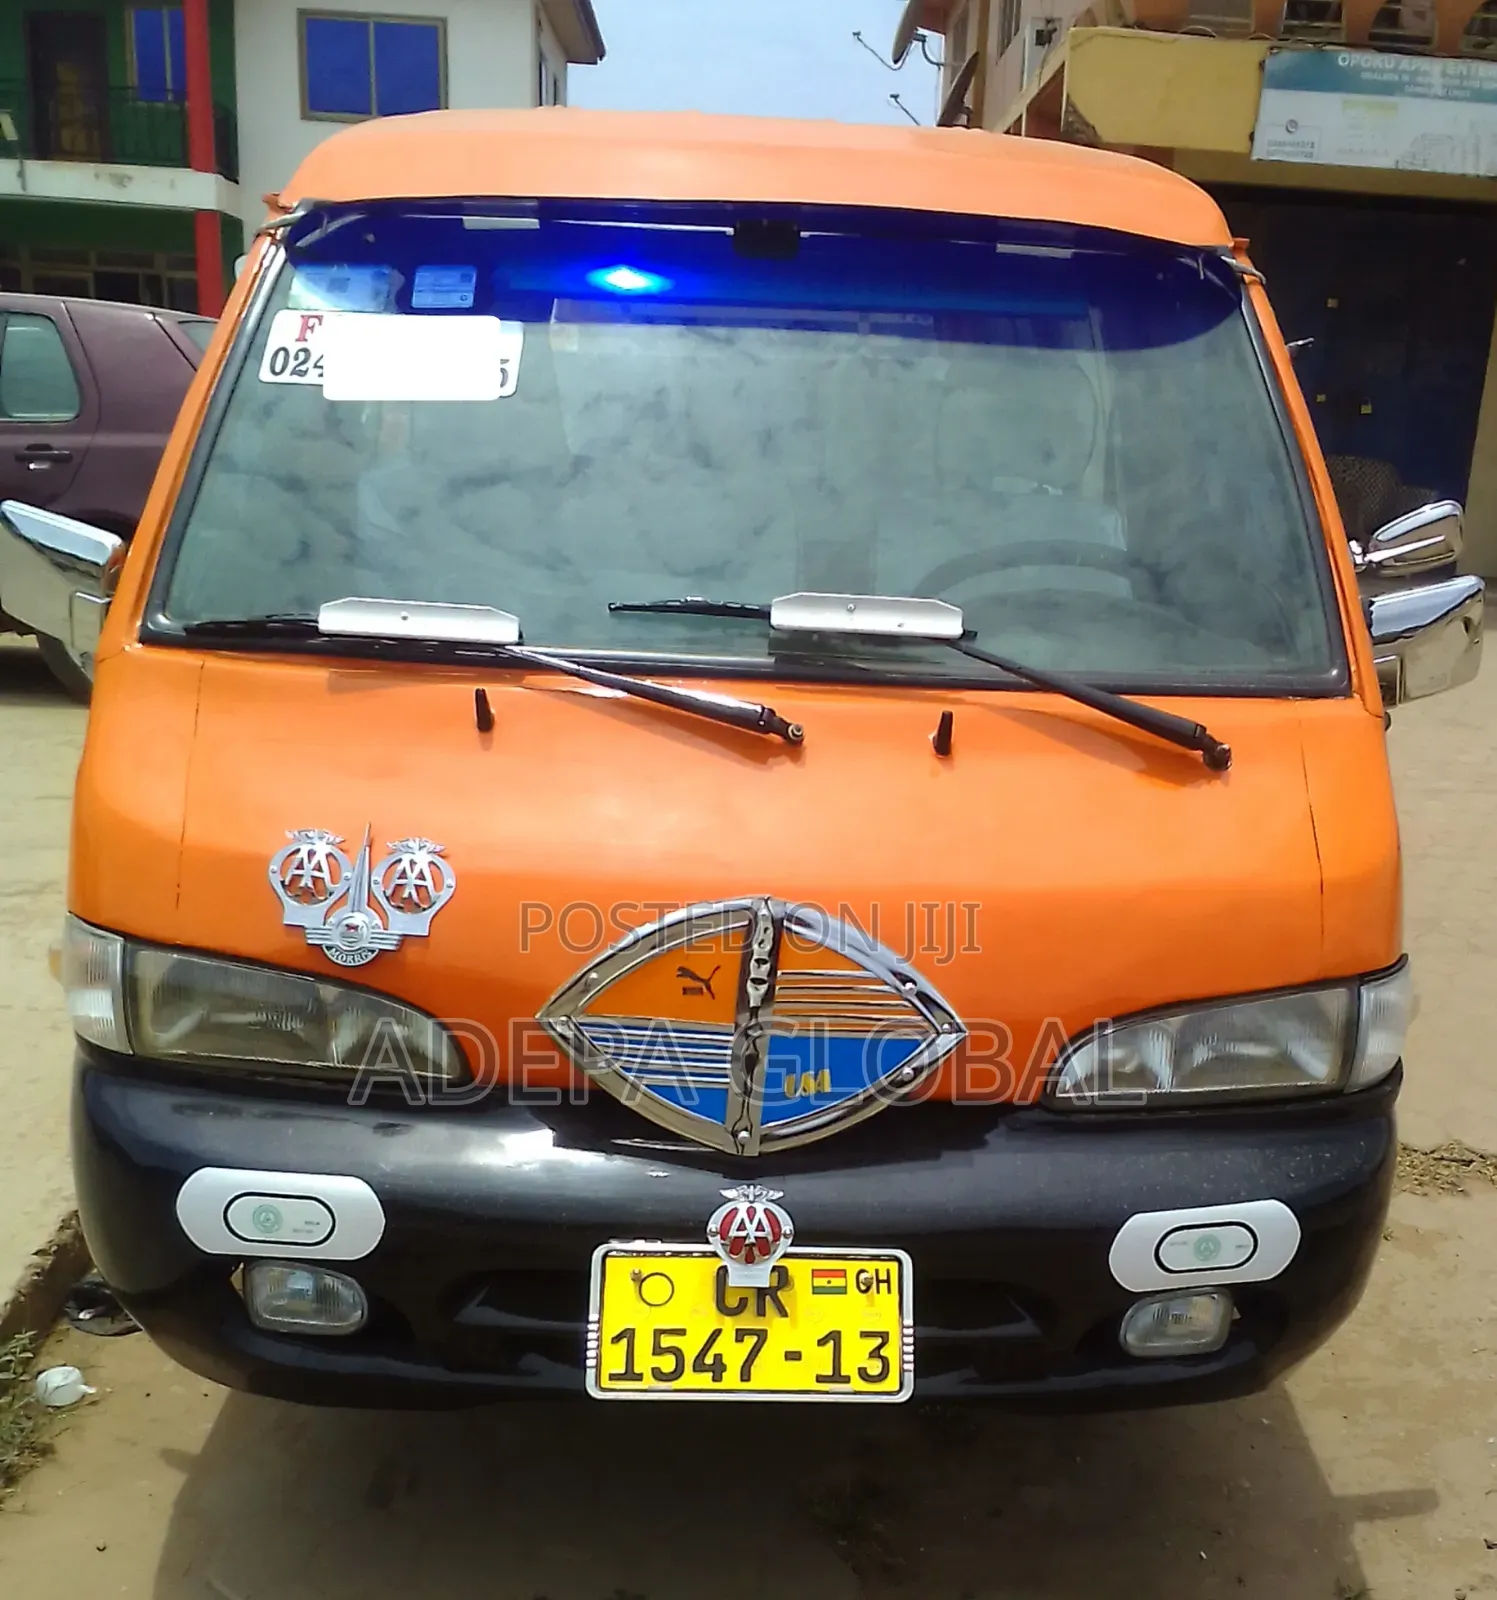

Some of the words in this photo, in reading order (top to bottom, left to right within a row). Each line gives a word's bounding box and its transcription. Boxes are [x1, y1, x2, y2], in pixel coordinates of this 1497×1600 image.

[1338, 52, 1395, 70] OPOKU
[295, 314, 324, 343] F
[327, 947, 373, 965] MORRIS
[714, 1264, 790, 1318] CR
